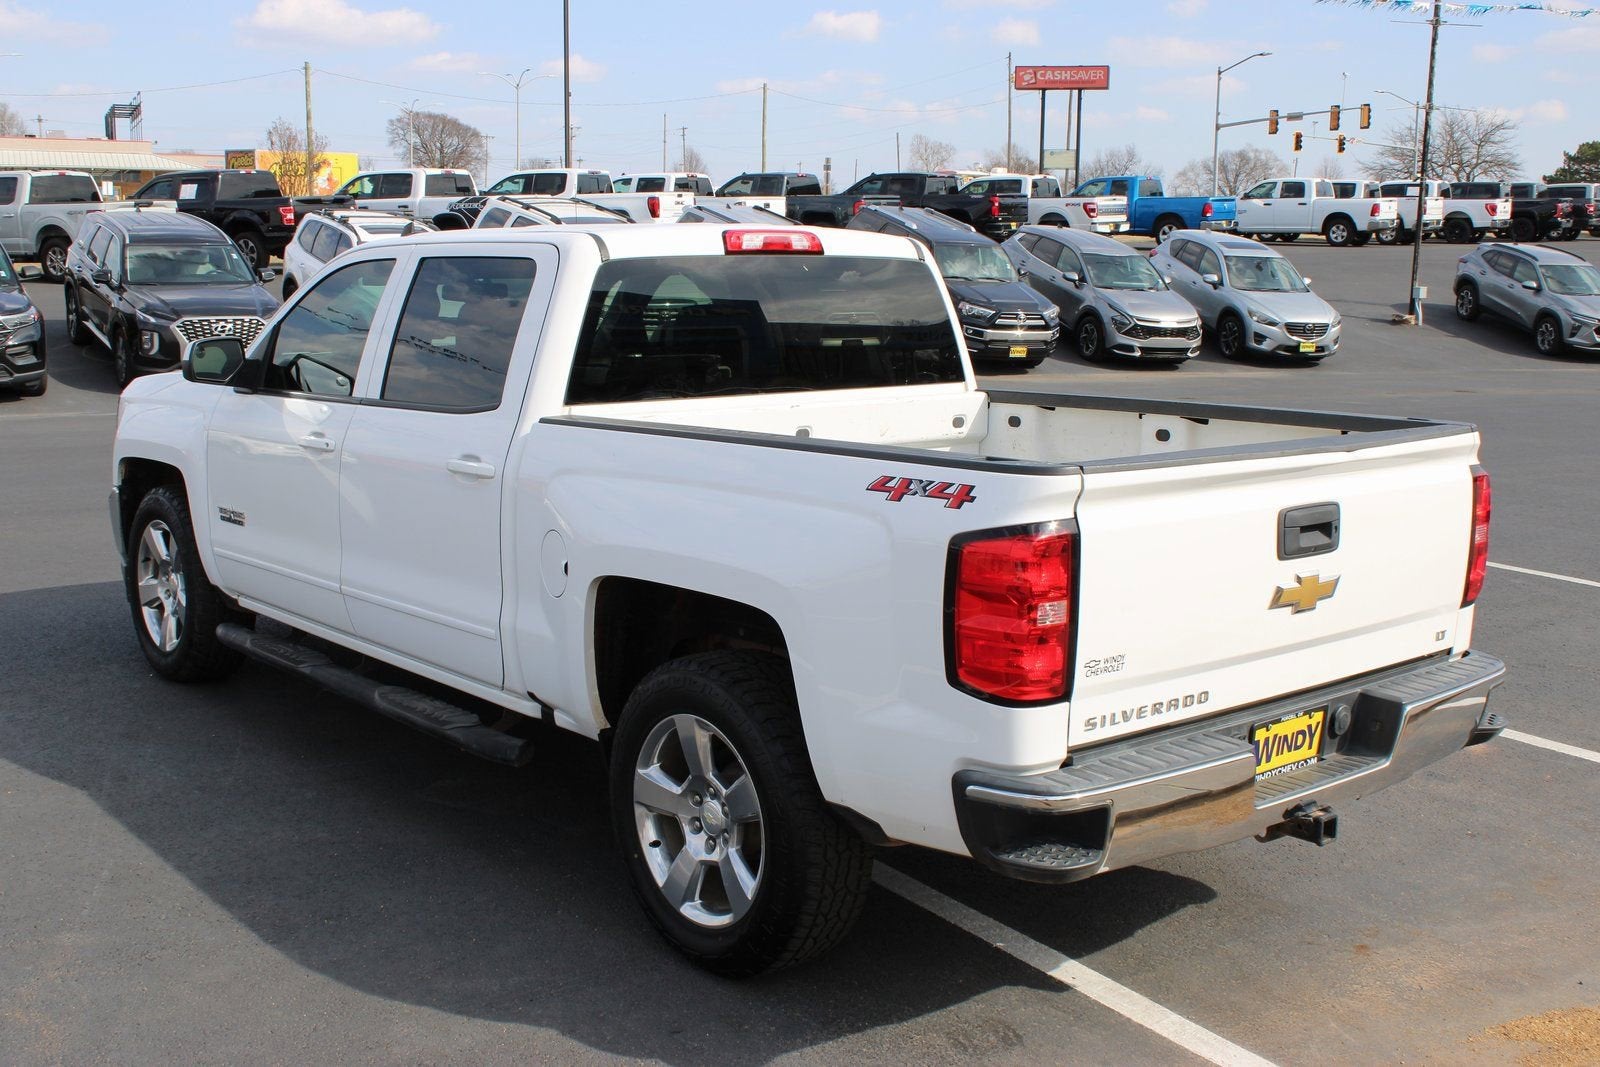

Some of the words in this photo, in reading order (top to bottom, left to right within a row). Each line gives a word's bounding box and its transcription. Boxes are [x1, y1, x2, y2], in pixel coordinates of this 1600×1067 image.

[1085, 662, 1125, 678] CHEVROLET
[1103, 653, 1126, 665] WINDY
[1083, 690, 1210, 732] SILVERADO
[1254, 721, 1321, 767] WINDY
